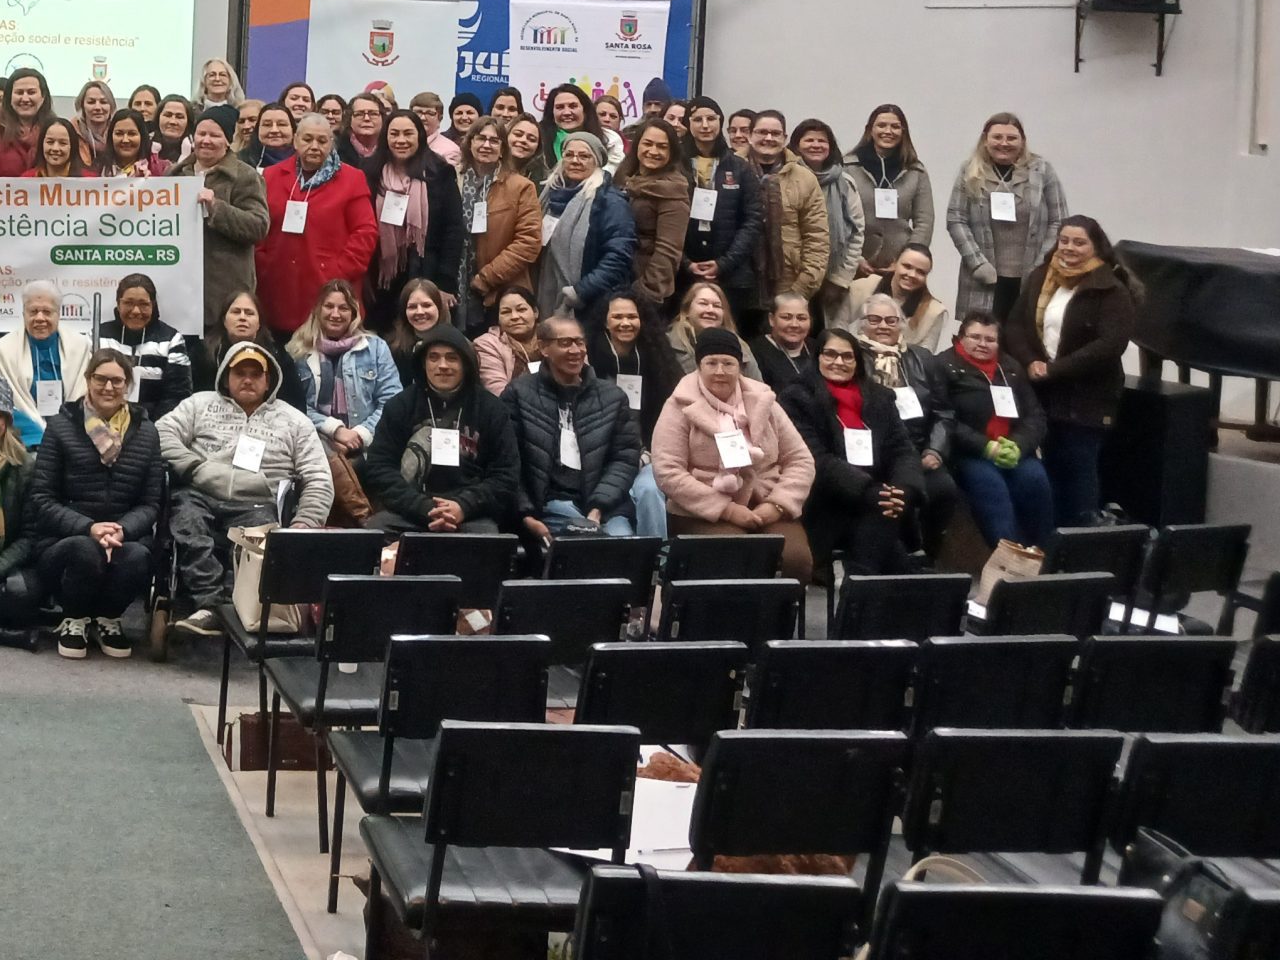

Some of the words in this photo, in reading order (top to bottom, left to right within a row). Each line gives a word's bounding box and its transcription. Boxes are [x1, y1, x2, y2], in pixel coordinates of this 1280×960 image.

[28, 34, 61, 45] social
[63, 36, 71, 45] e
[605, 42, 629, 50] SANTA
[631, 43, 653, 51] ROSA
[471, 74, 509, 84] REGIONAL
[39, 183, 180, 212] Municipal
[98, 213, 180, 237] Social
[55, 249, 102, 261] SANTA
[104, 249, 145, 261] ROSA
[156, 249, 176, 261] RS
[62, 278, 69, 287] e
[72, 277, 121, 288] resistên
